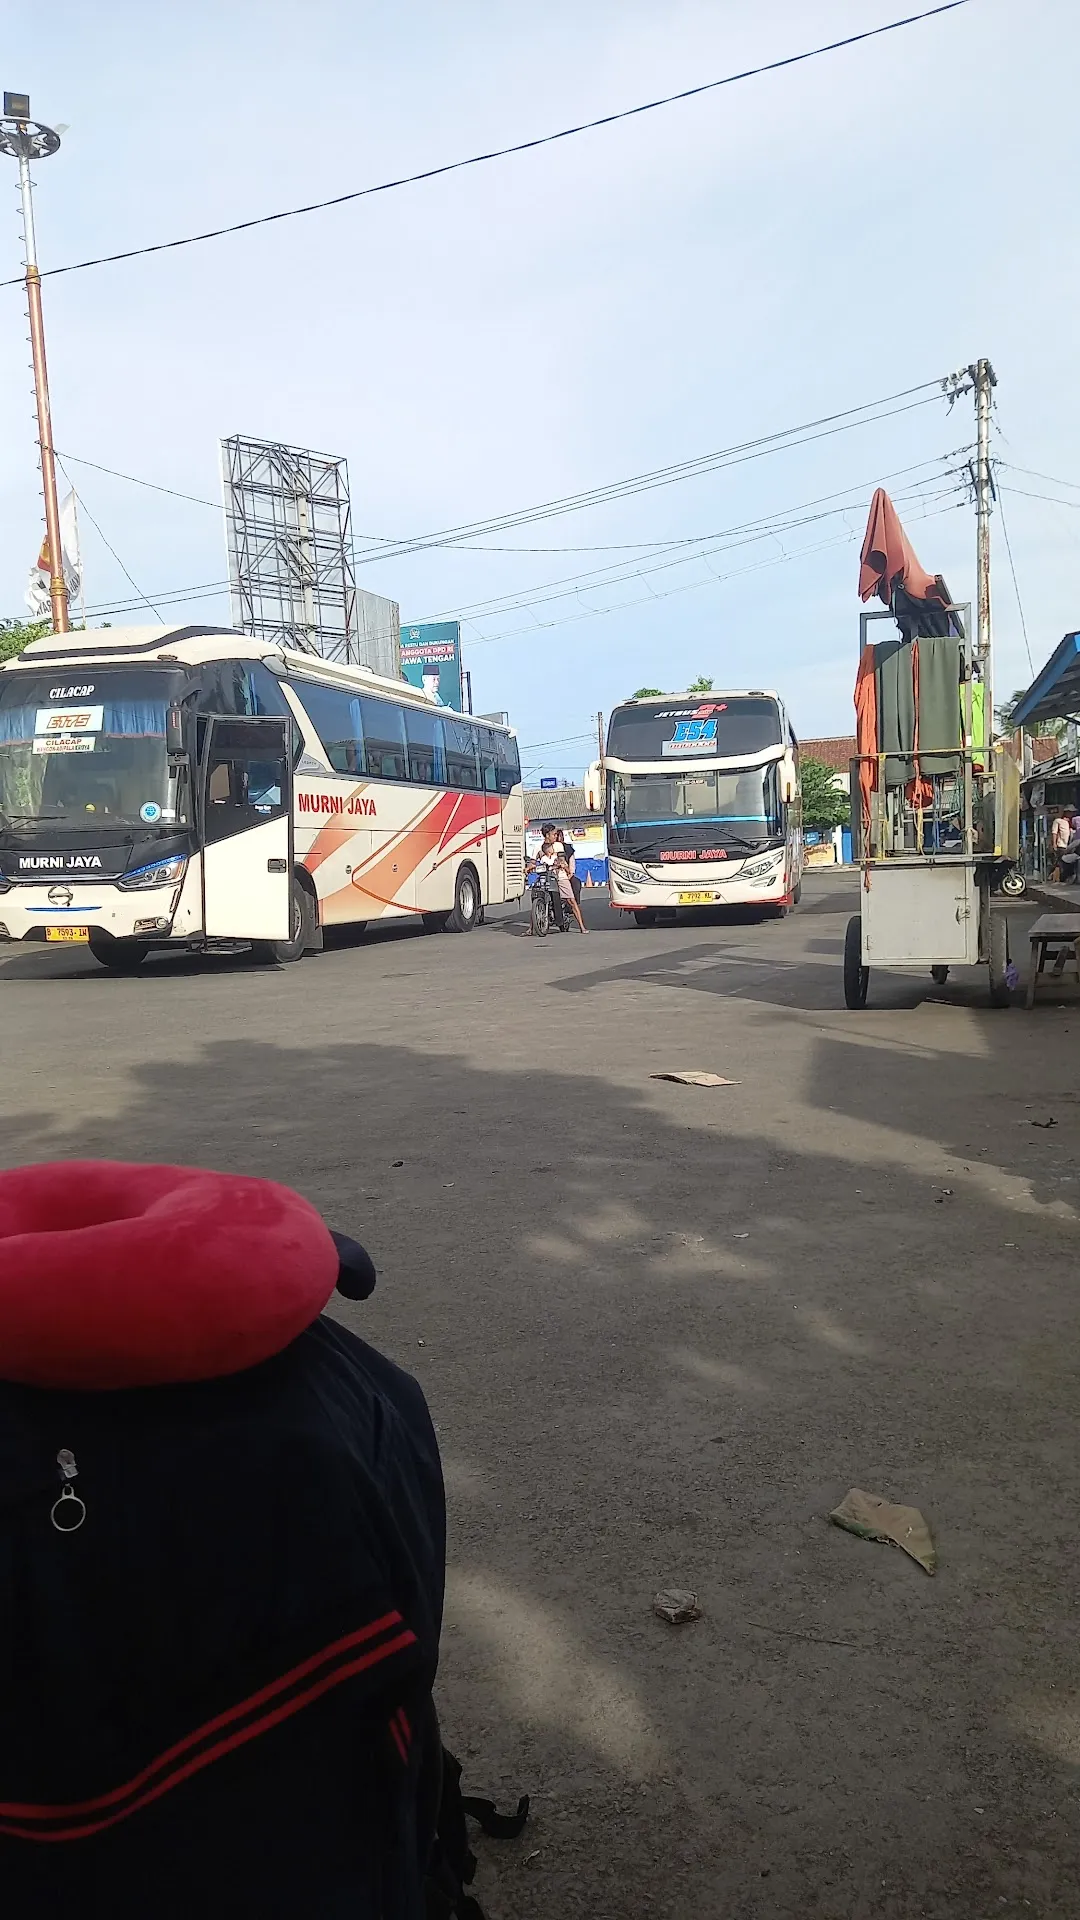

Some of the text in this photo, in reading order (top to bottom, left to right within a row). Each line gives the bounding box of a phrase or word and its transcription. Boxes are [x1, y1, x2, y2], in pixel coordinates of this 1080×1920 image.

[401, 648, 431, 656] ANGGOTA
[432, 646, 445, 654] DPD
[402, 654, 455, 665] JAWA TENGAH
[49, 685, 95, 699] CILACAP
[671, 719, 718, 741] E54
[45, 738, 82, 746] CILACAP
[298, 793, 377, 816] MURNI JAYA
[660, 848, 728, 861] MURNI JAYA
[19, 856, 102, 869] MURNI JAYA
[46, 928, 52, 936] B
